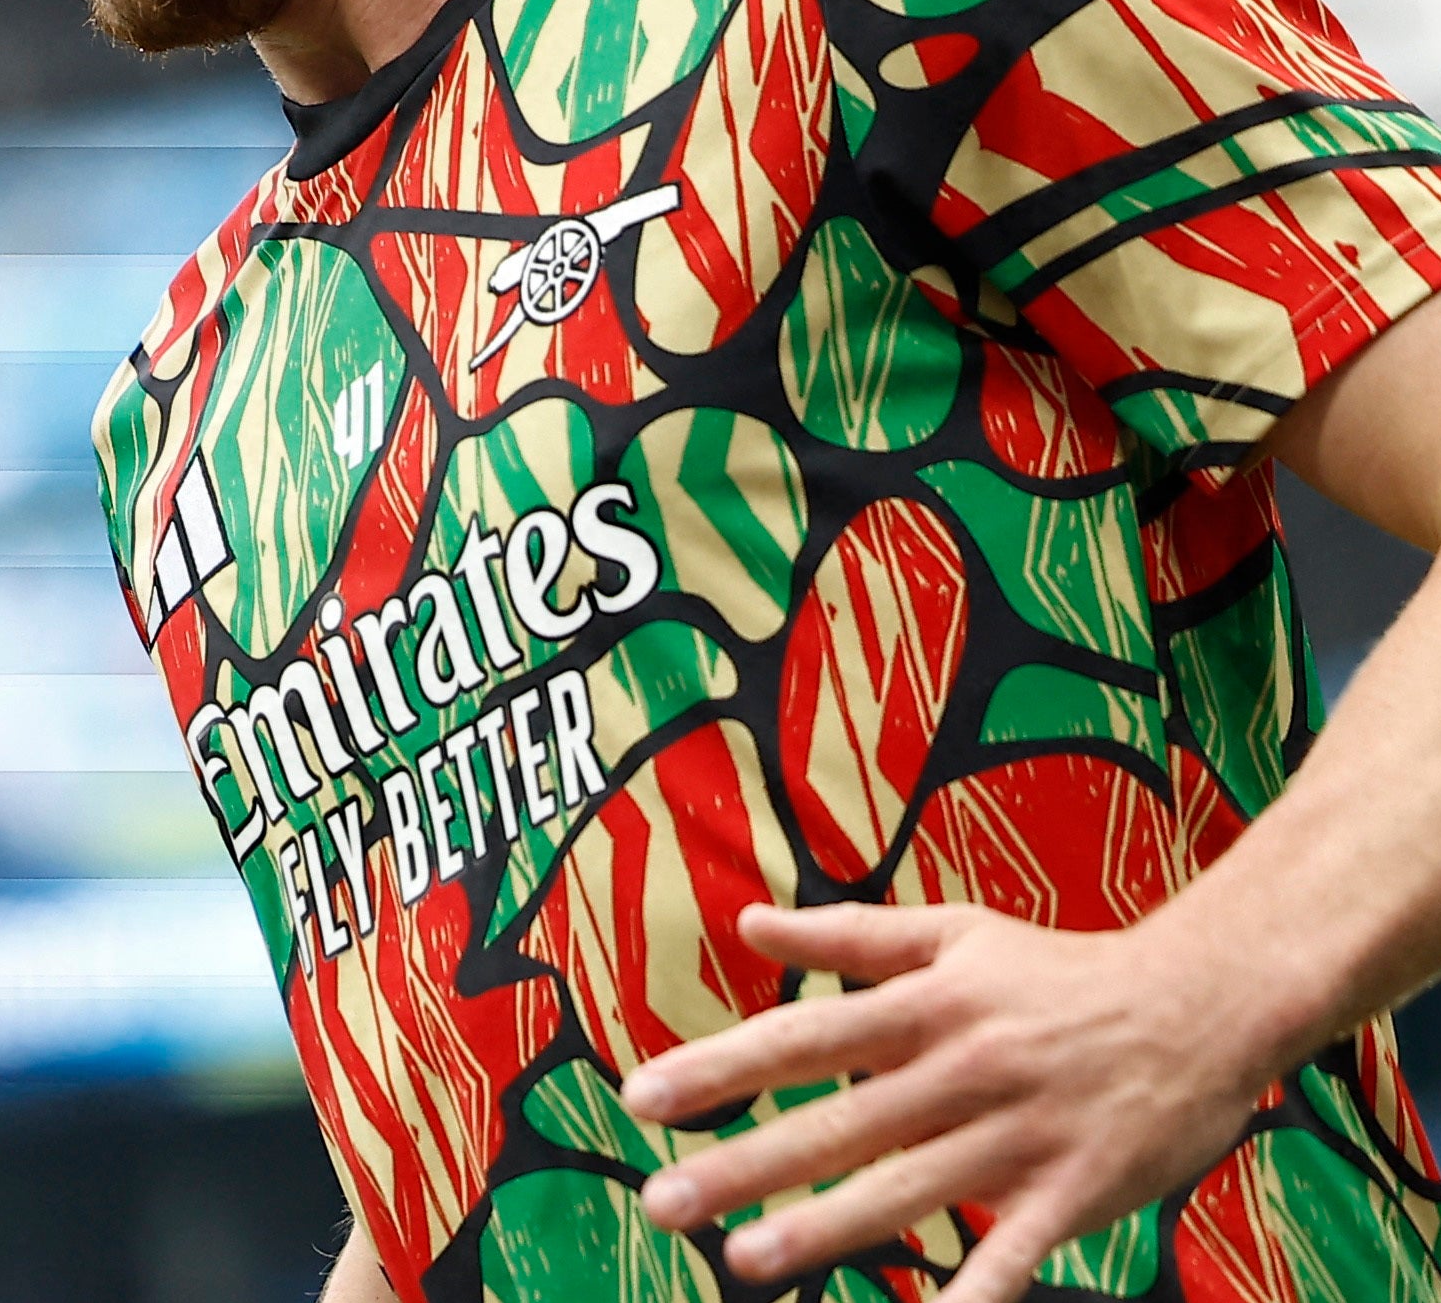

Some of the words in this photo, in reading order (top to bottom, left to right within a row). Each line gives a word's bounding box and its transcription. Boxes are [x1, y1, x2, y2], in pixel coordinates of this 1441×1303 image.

[333, 358, 385, 470] 41
[186, 480, 661, 863] Emirates
[280, 799, 373, 979] FLY
[381, 668, 607, 908] BETTER
